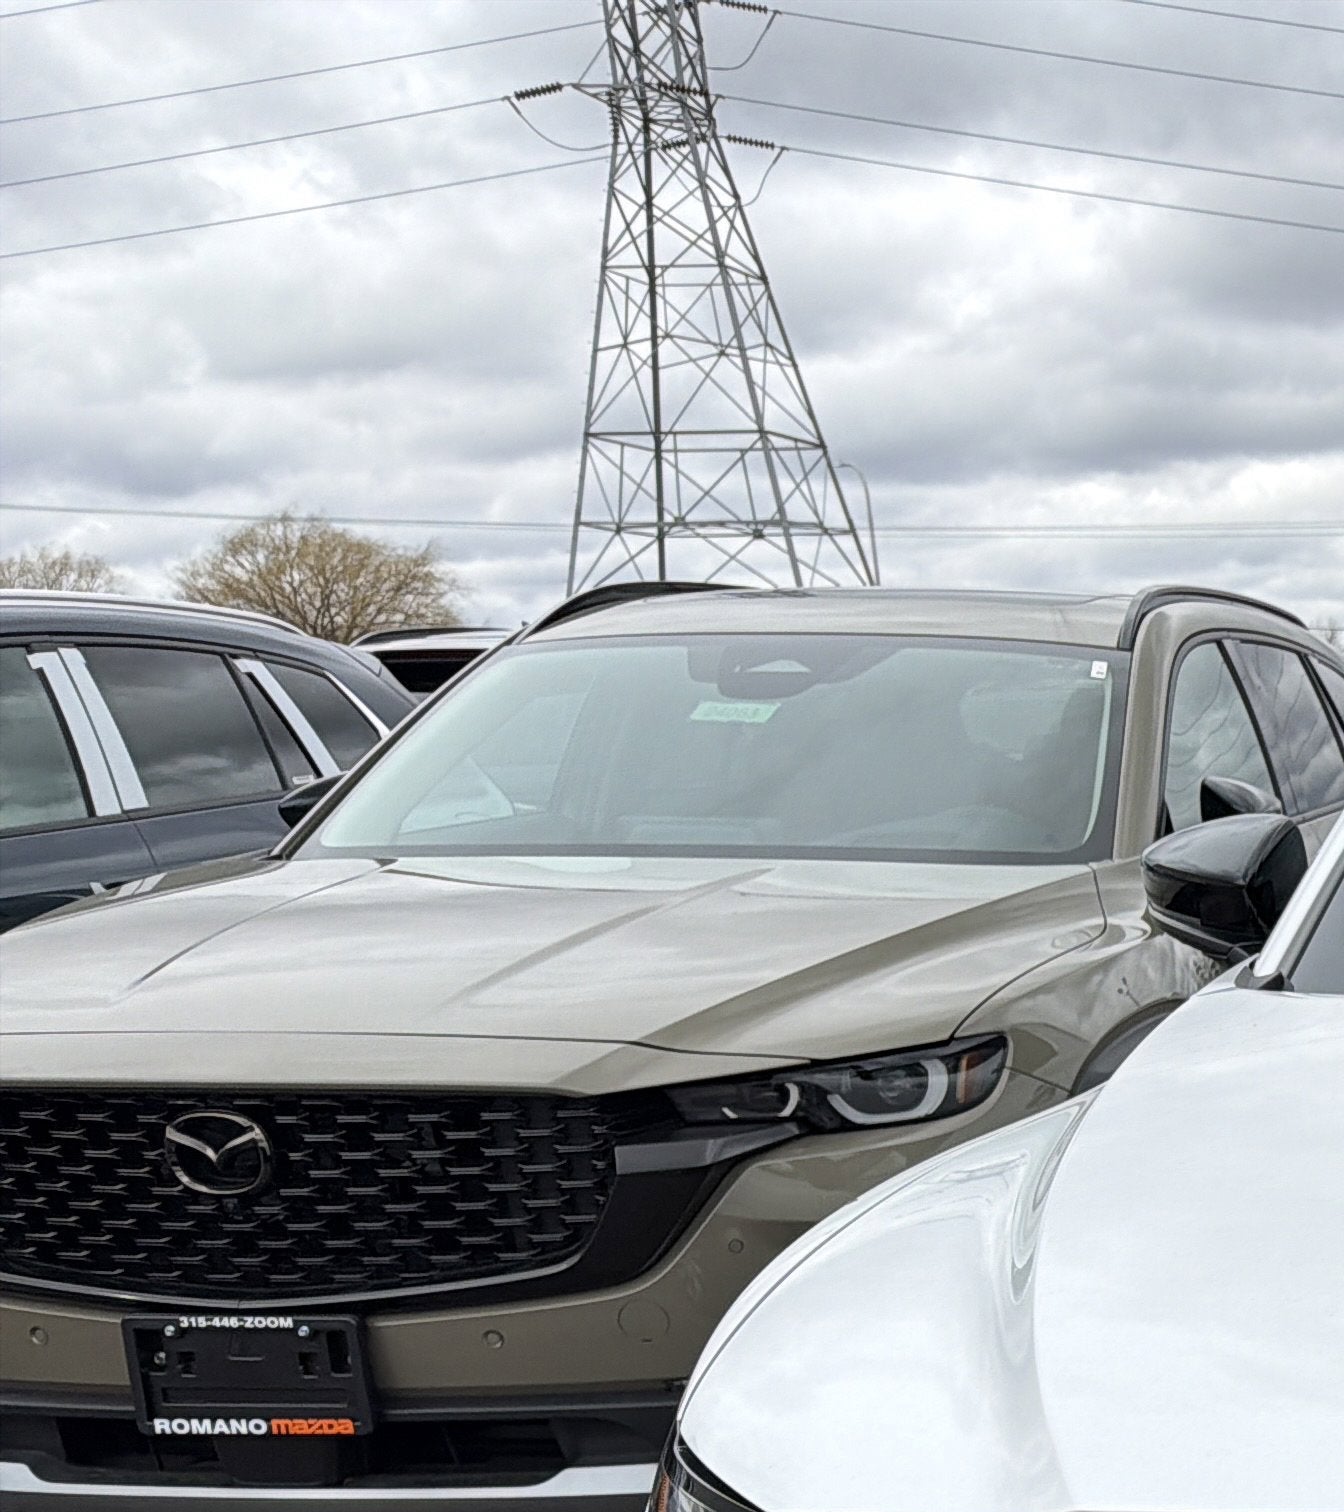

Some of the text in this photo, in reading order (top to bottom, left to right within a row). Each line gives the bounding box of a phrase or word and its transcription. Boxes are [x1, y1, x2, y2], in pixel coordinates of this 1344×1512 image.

[178, 1316, 294, 1329] 315-446-ZOOM
[153, 1418, 355, 1436] ROMANO mazda
